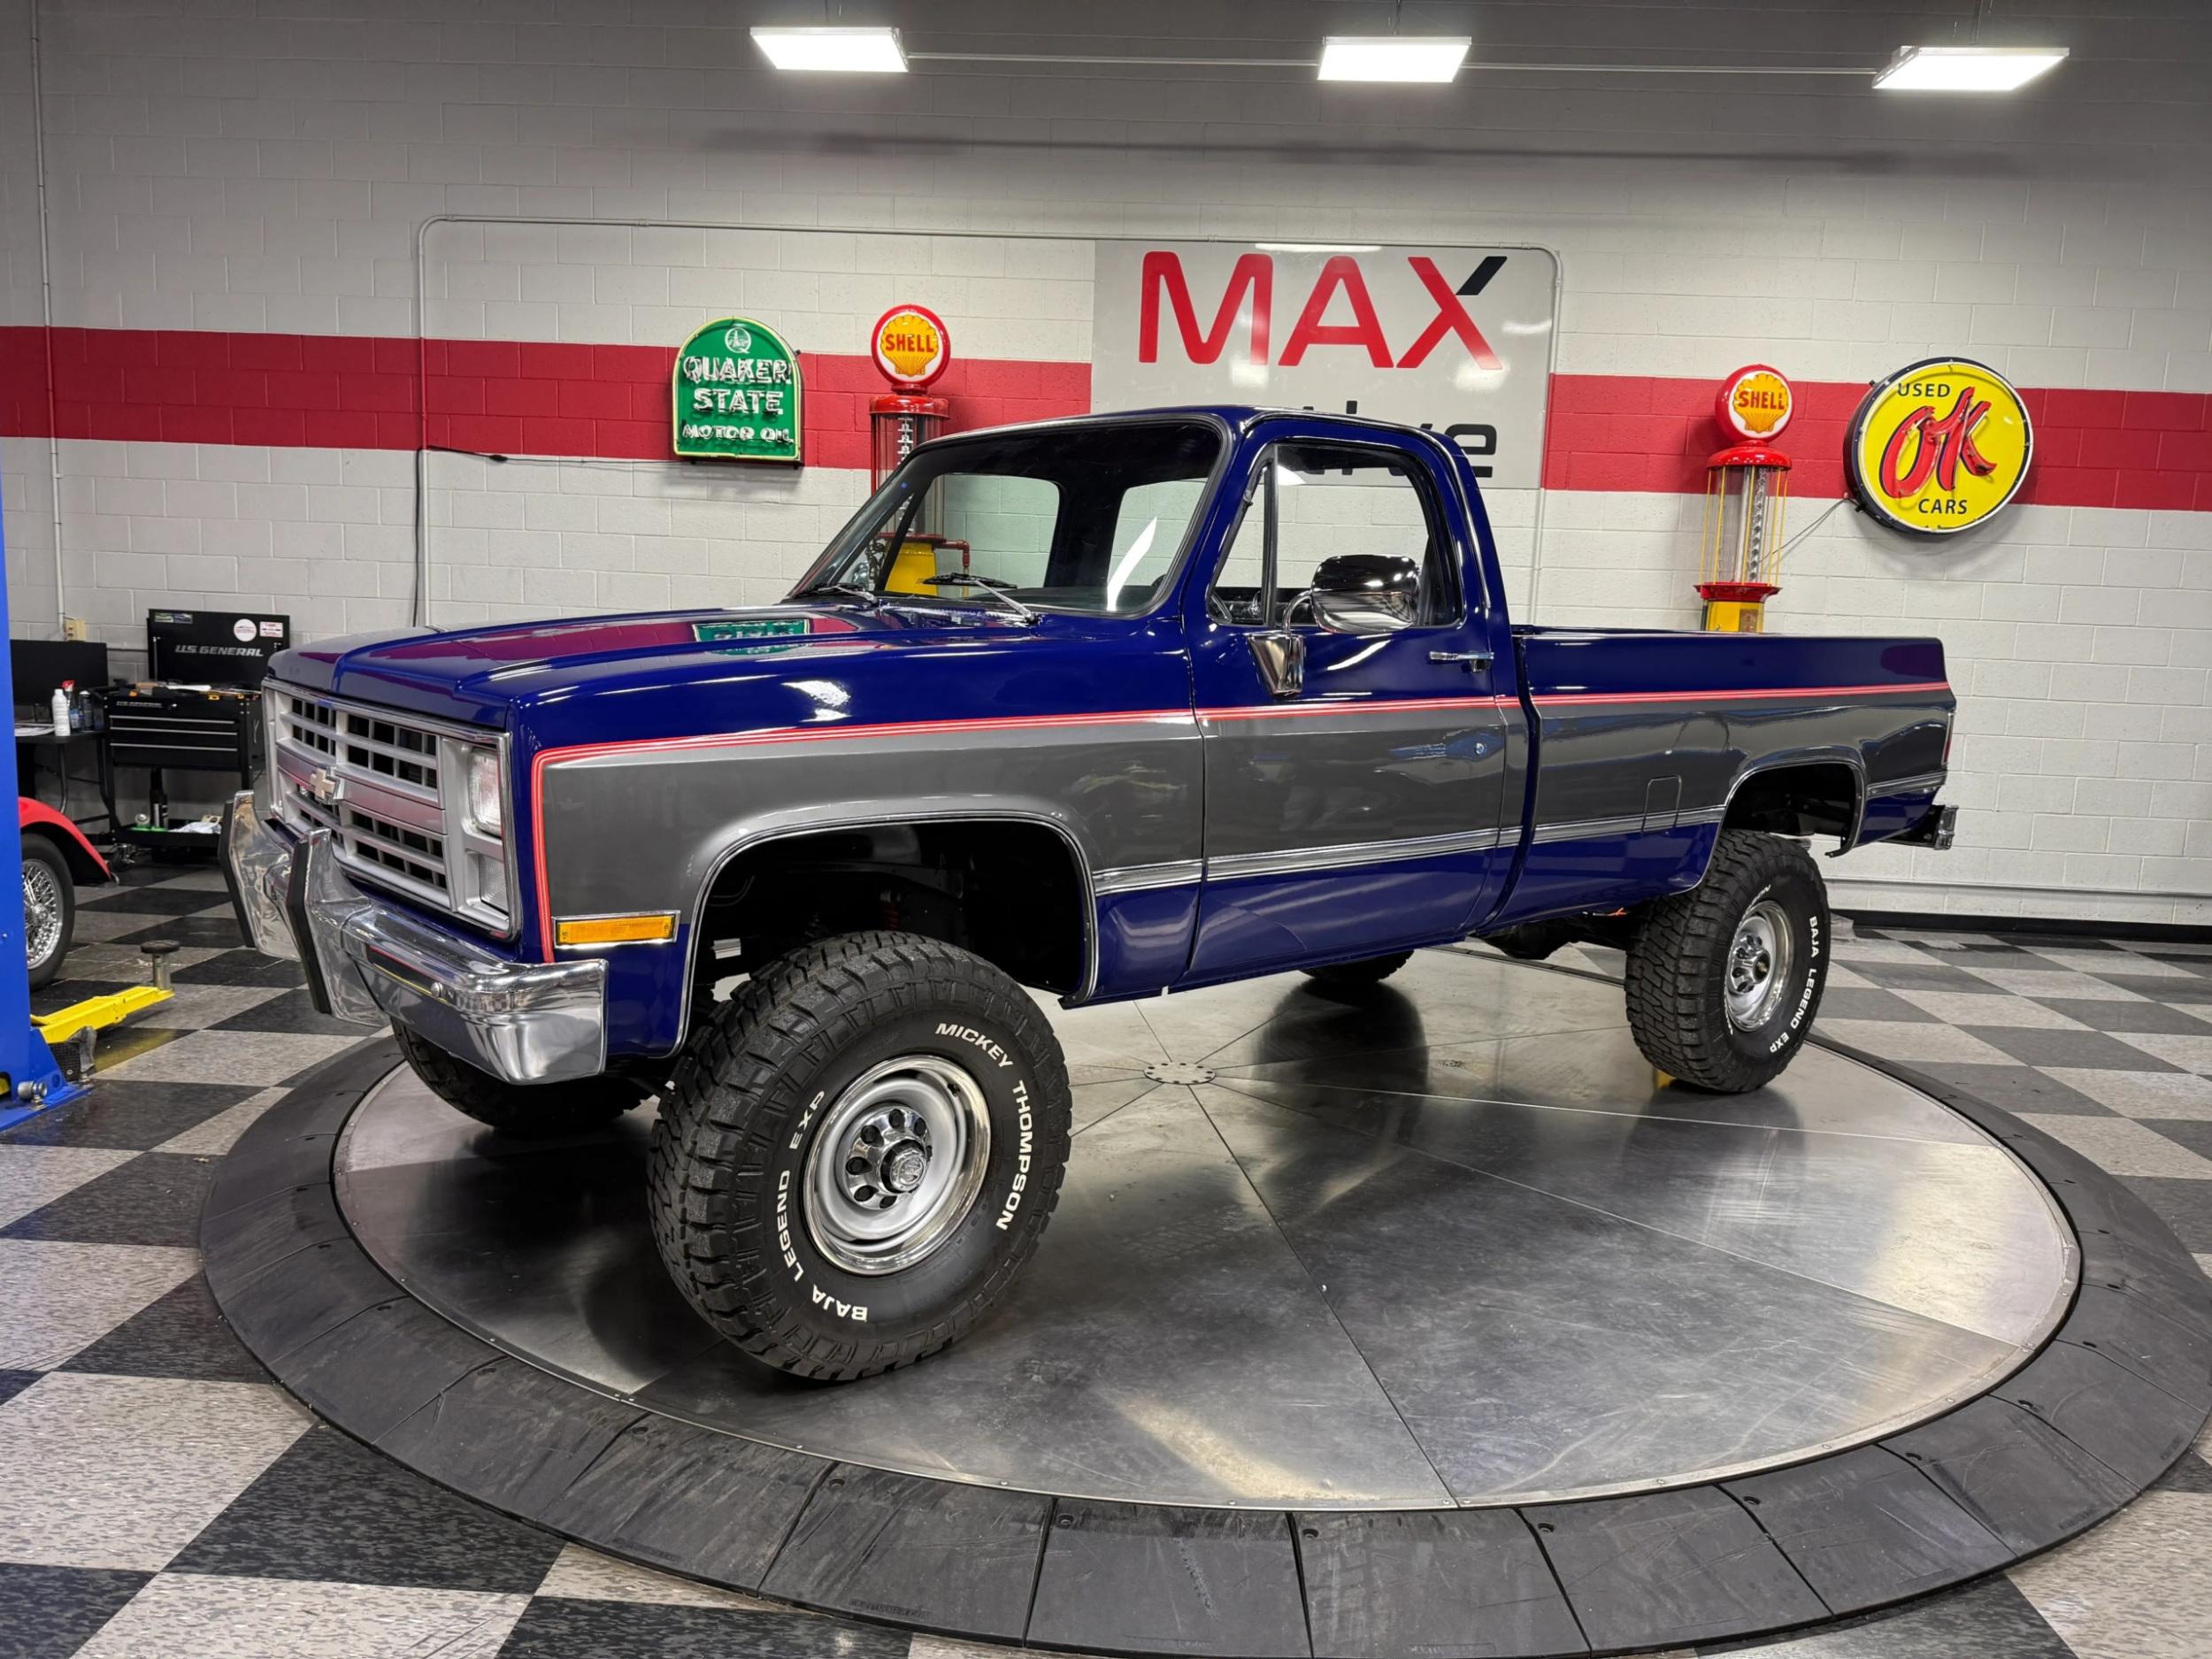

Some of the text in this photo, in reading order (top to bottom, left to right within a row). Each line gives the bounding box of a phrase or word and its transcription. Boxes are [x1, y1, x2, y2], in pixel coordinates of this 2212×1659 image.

[1138, 250, 1508, 370] MAX
[885, 334, 934, 352] SHELL
[683, 356, 792, 384] QUAKER
[694, 388, 784, 415] STATE
[1738, 390, 1785, 410] SHELL
[1898, 383, 1950, 397] USED
[682, 424, 794, 442] MOTOR OIL
[1918, 498, 1968, 514] CARS
[199, 646, 264, 657] GENERAL
[1770, 916, 1819, 1054] BAJA LEGEND EXP
[935, 1023, 1033, 1230] MICKEY THOMPSON
[777, 1090, 868, 1321] BAJA LEGEND EXP
